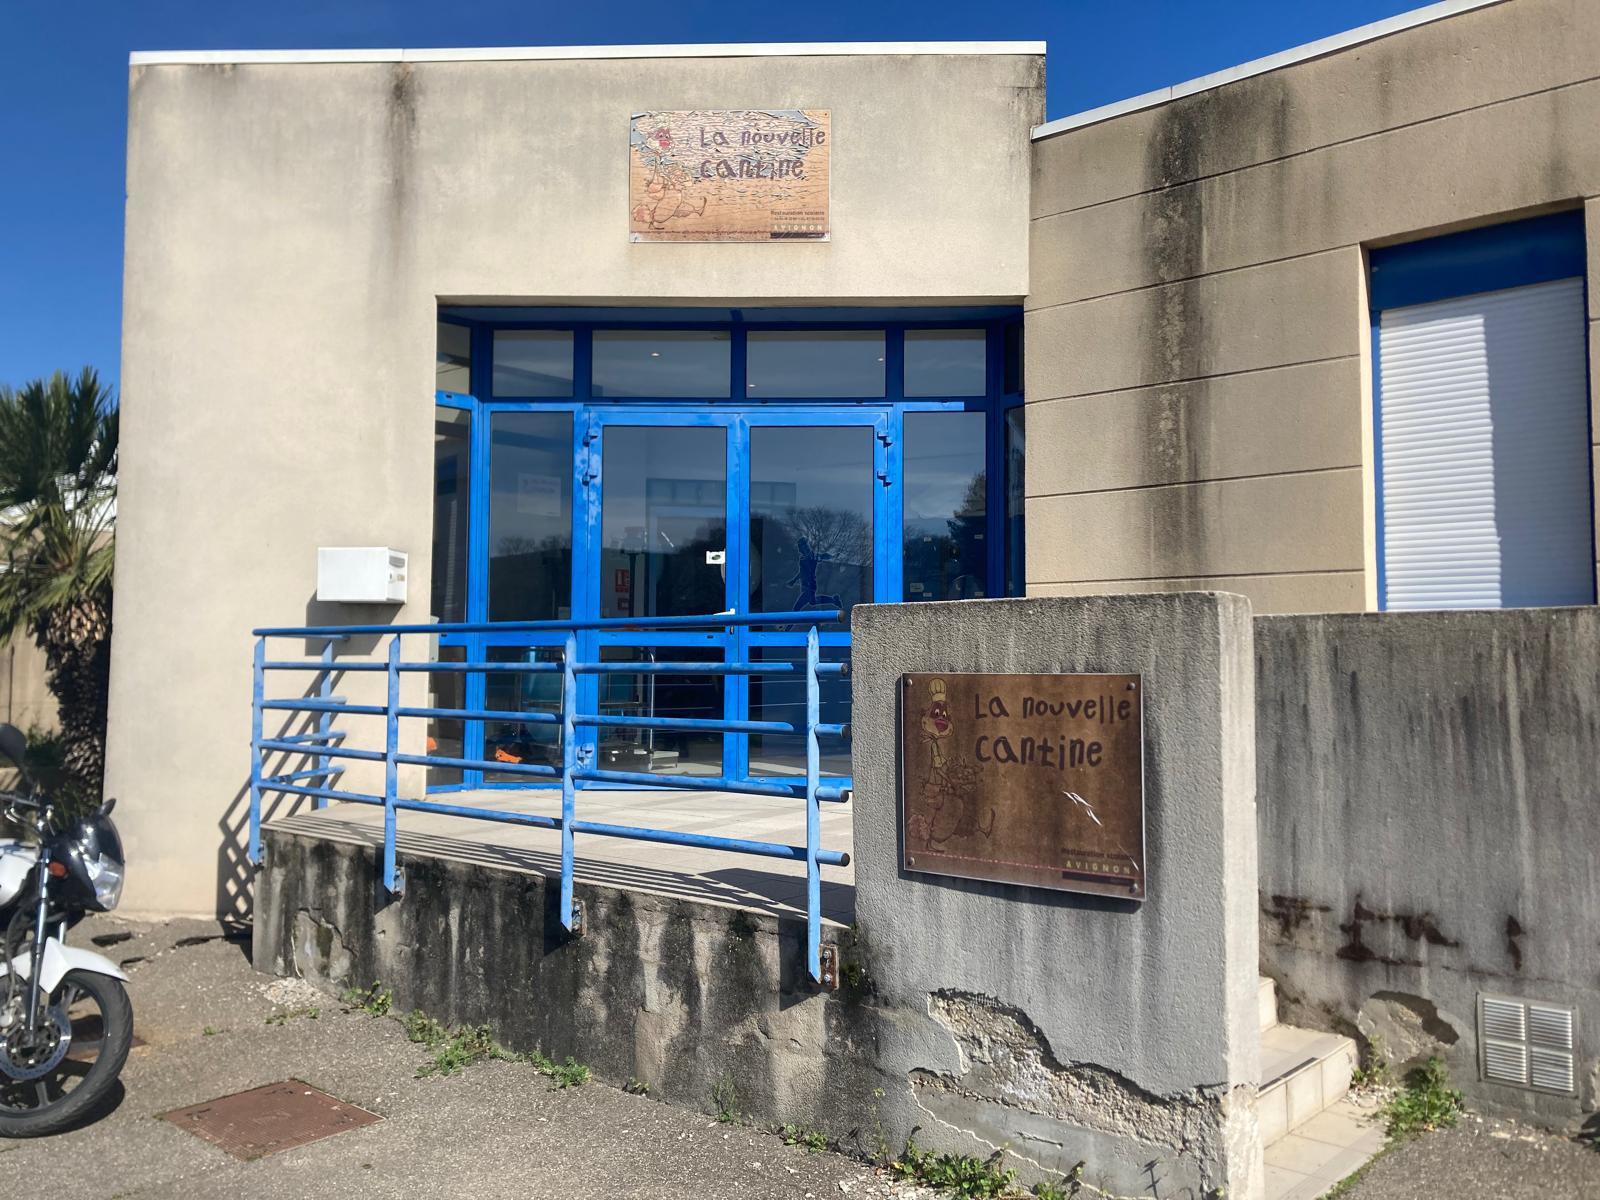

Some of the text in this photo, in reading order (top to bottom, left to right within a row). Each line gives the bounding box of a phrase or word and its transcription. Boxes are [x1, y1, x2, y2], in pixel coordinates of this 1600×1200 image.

[701, 128, 826, 148] La nouvelle
[700, 159, 804, 180] cantine
[975, 693, 1131, 724] La nouvelle
[975, 734, 1103, 770] cantine
[1066, 860, 1130, 875] AVIGNON
